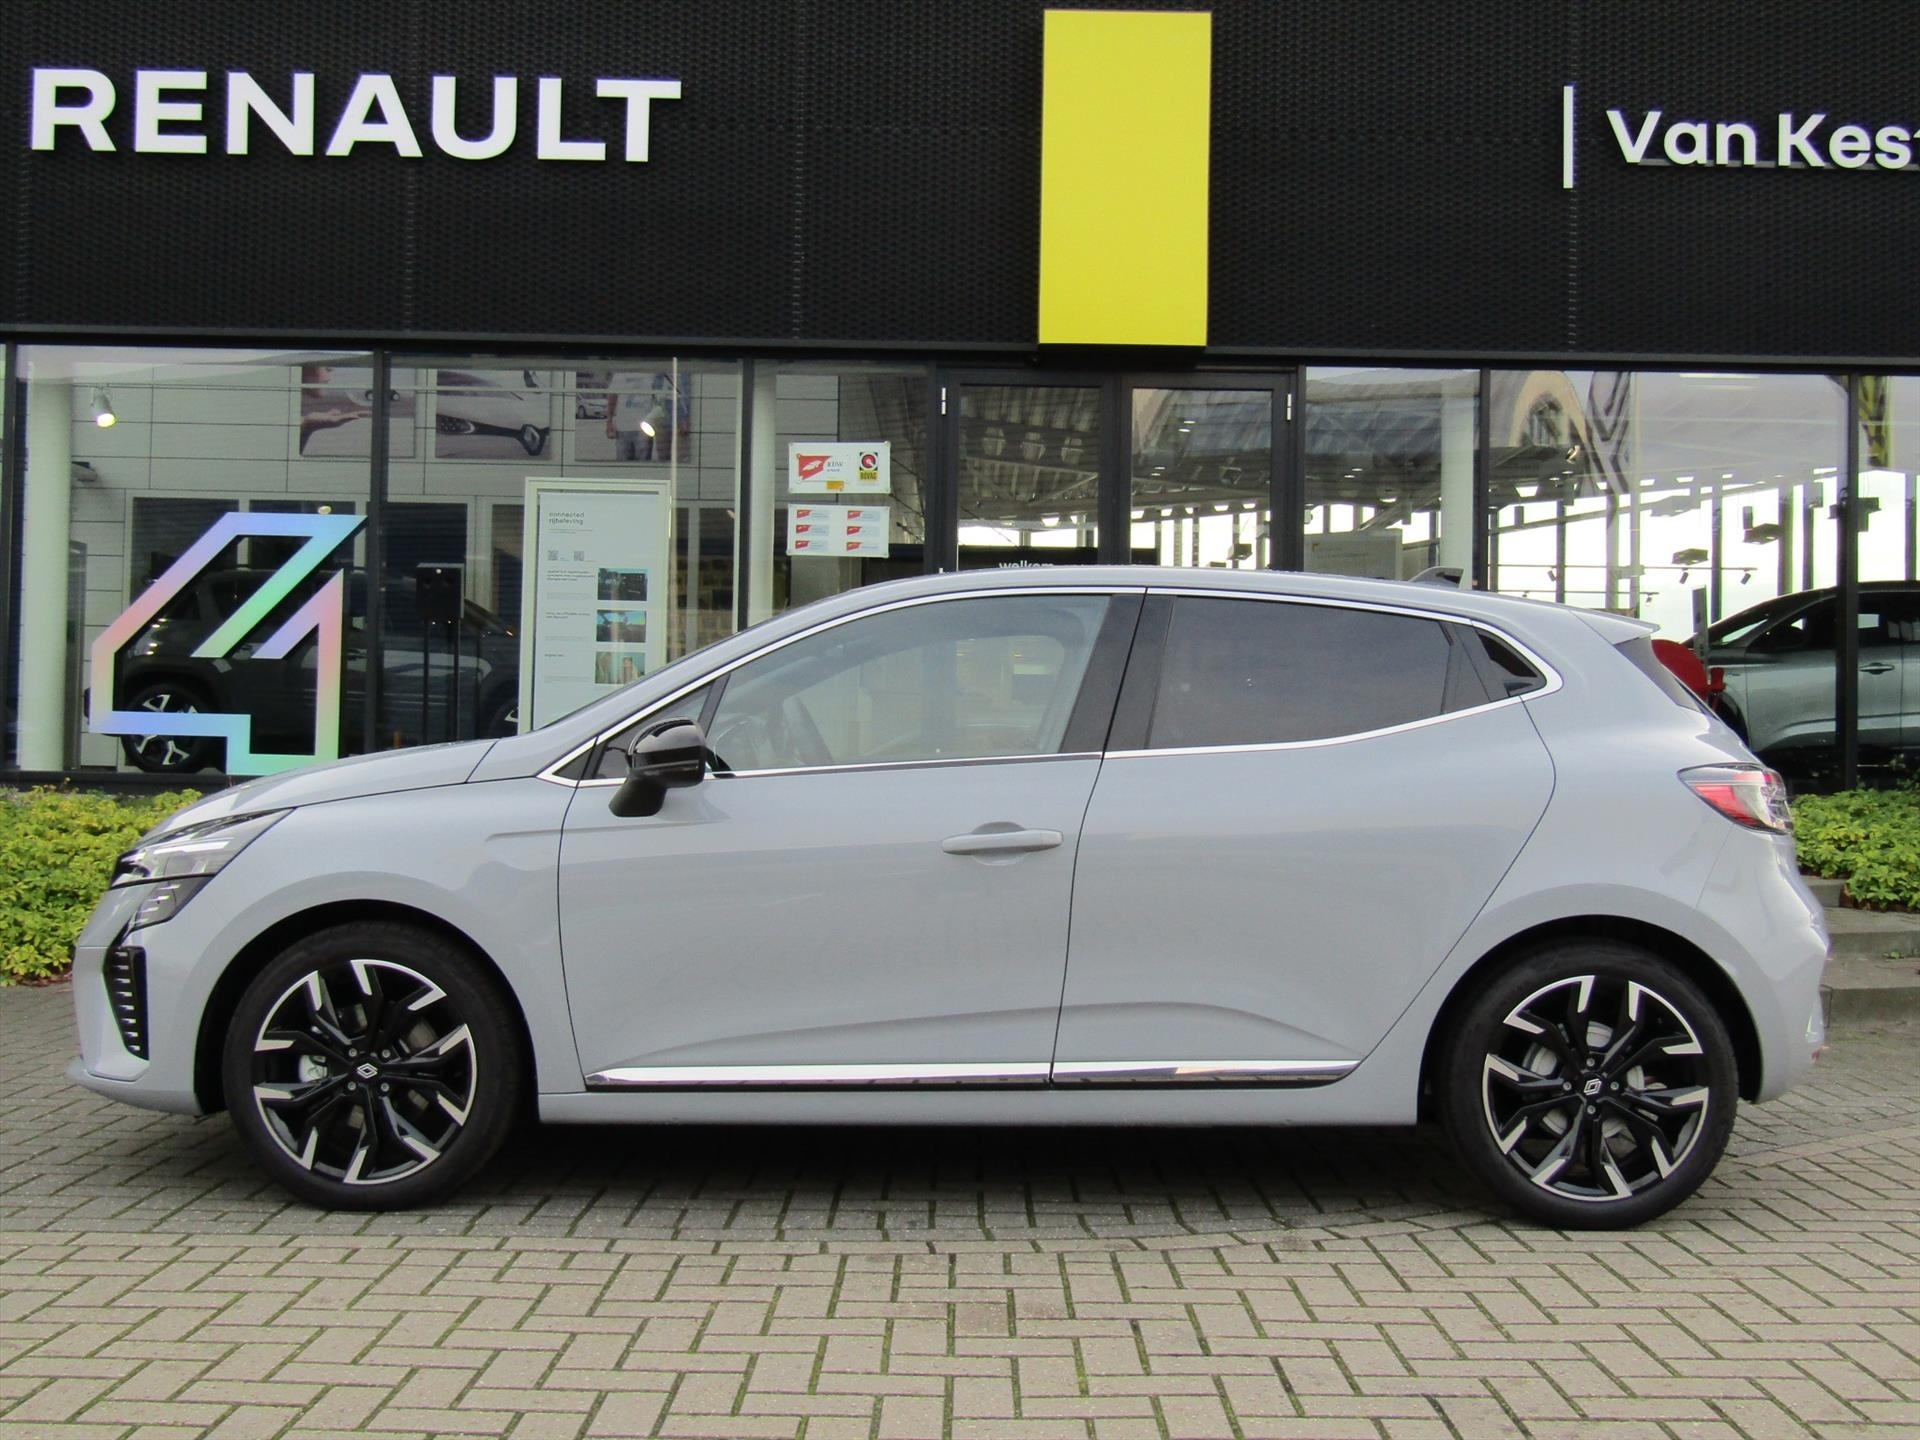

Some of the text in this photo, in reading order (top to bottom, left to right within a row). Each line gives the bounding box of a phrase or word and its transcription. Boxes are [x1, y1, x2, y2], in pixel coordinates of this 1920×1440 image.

[31, 68, 681, 162] RENAULT
[1606, 110, 1920, 169] Van Kes
